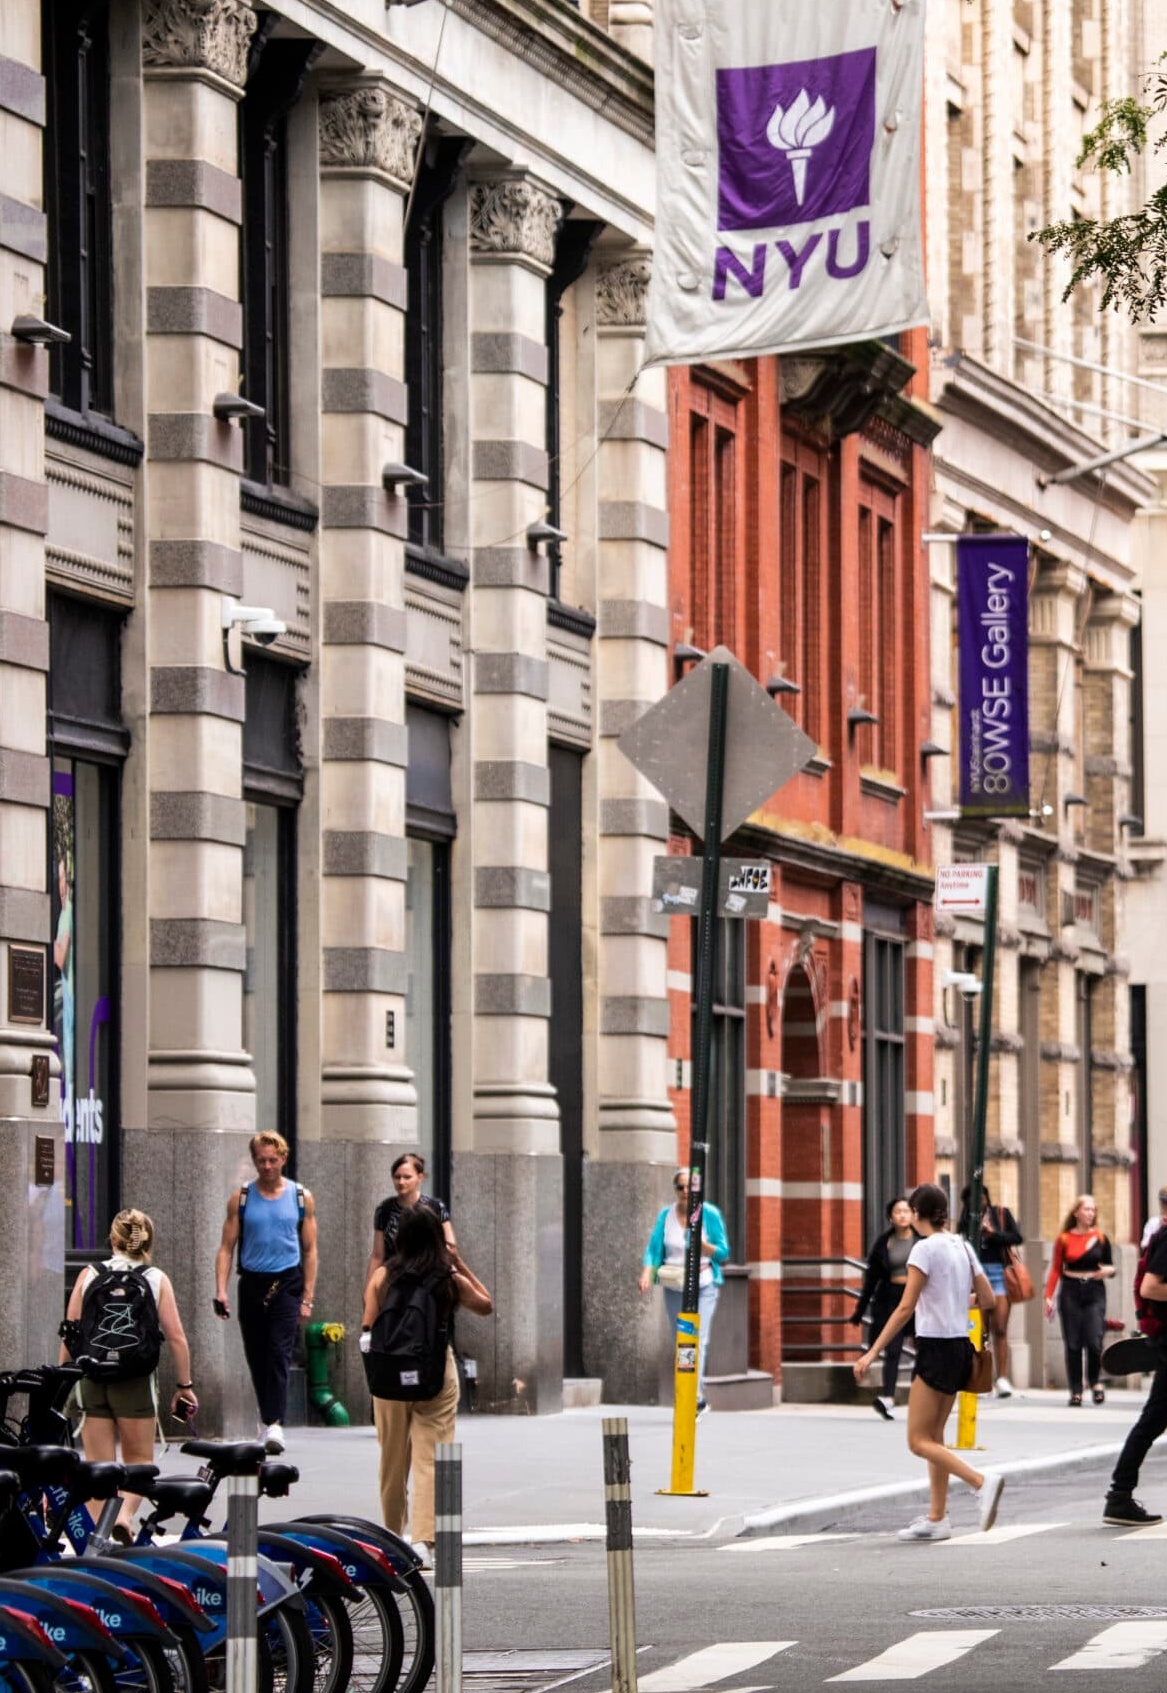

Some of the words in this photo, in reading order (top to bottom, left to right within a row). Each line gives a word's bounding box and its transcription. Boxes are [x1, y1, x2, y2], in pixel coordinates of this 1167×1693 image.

[712, 221, 870, 301] NYU
[981, 562, 1015, 669] Gallery
[982, 676, 1012, 794] 80WSE
[940, 870, 950, 878] NO
[952, 870, 983, 878] PARKING
[67, 1509, 85, 1540] ike
[193, 1588, 222, 1606] ike
